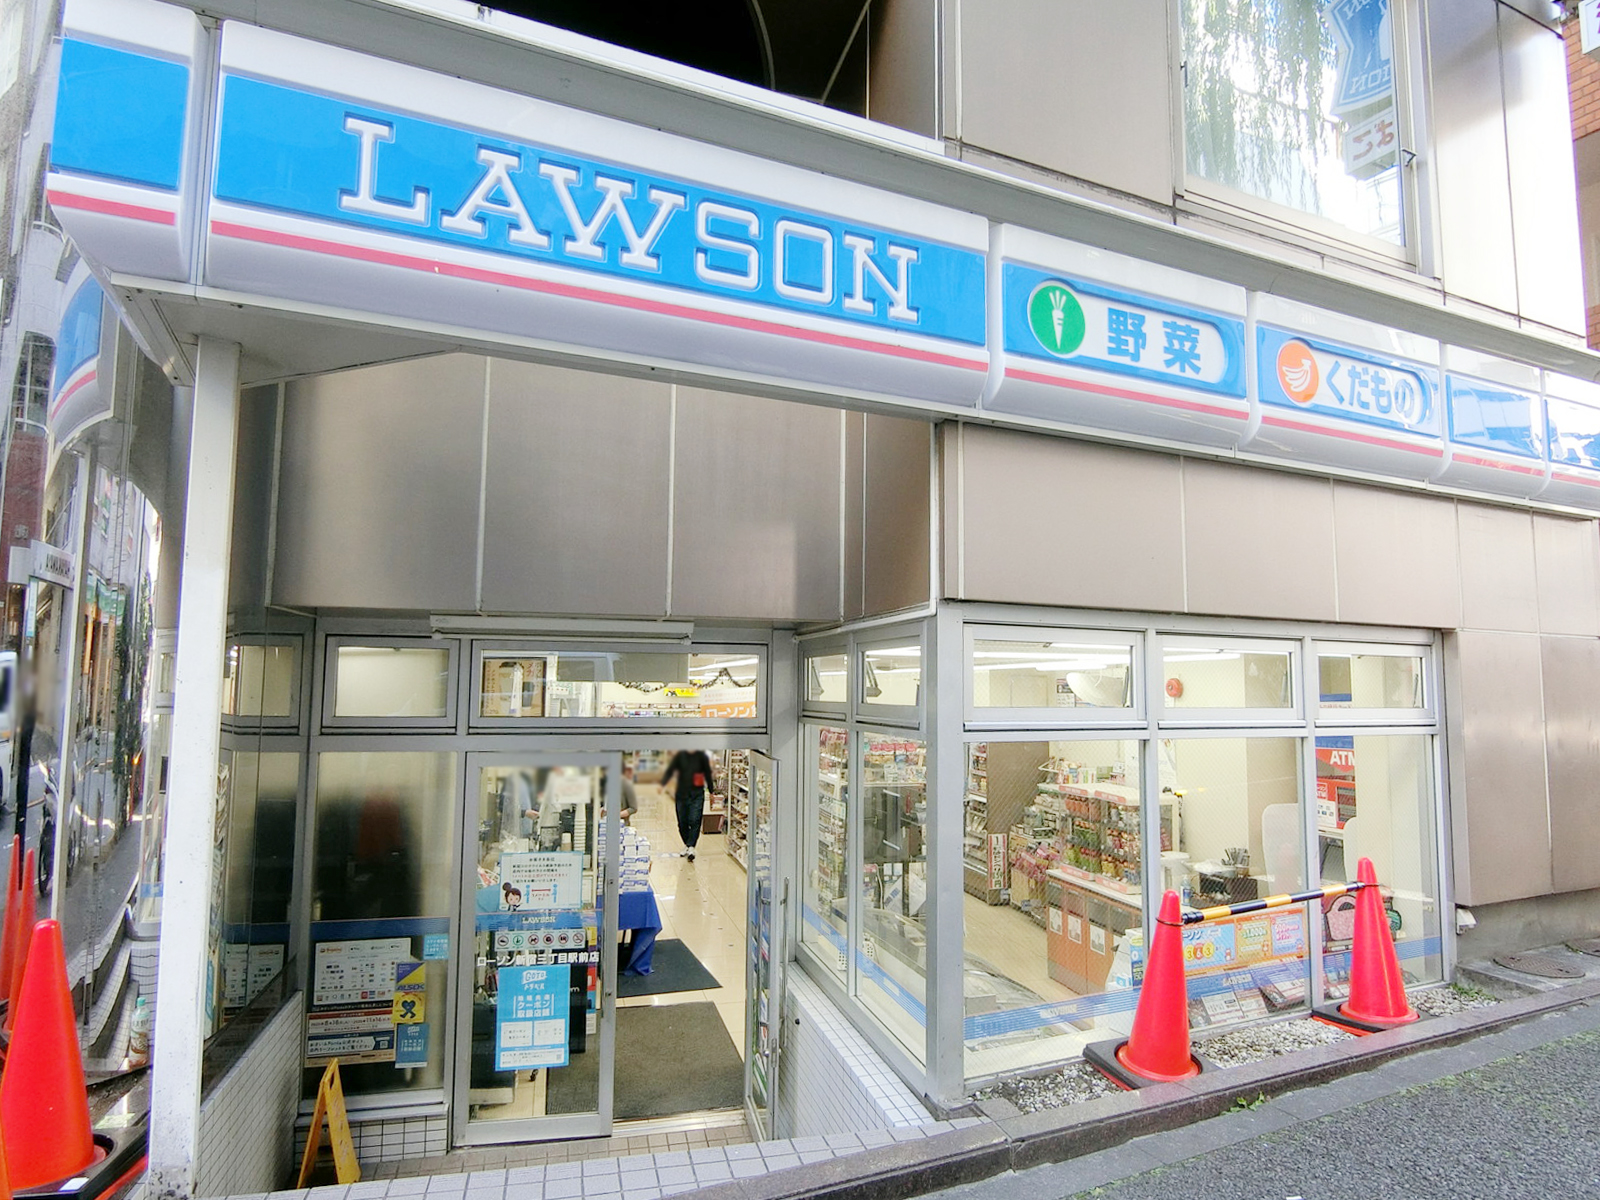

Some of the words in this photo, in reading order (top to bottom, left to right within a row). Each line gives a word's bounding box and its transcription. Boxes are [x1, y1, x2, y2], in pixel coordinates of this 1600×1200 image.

[339, 115, 919, 322] LAWSON
[1107, 307, 1202, 376] 野菜
[1326, 360, 1414, 417] くだもの
[477, 951, 600, 967] ローソン新宿三丁目駅前店
[517, 1000, 551, 1010] クーポン
